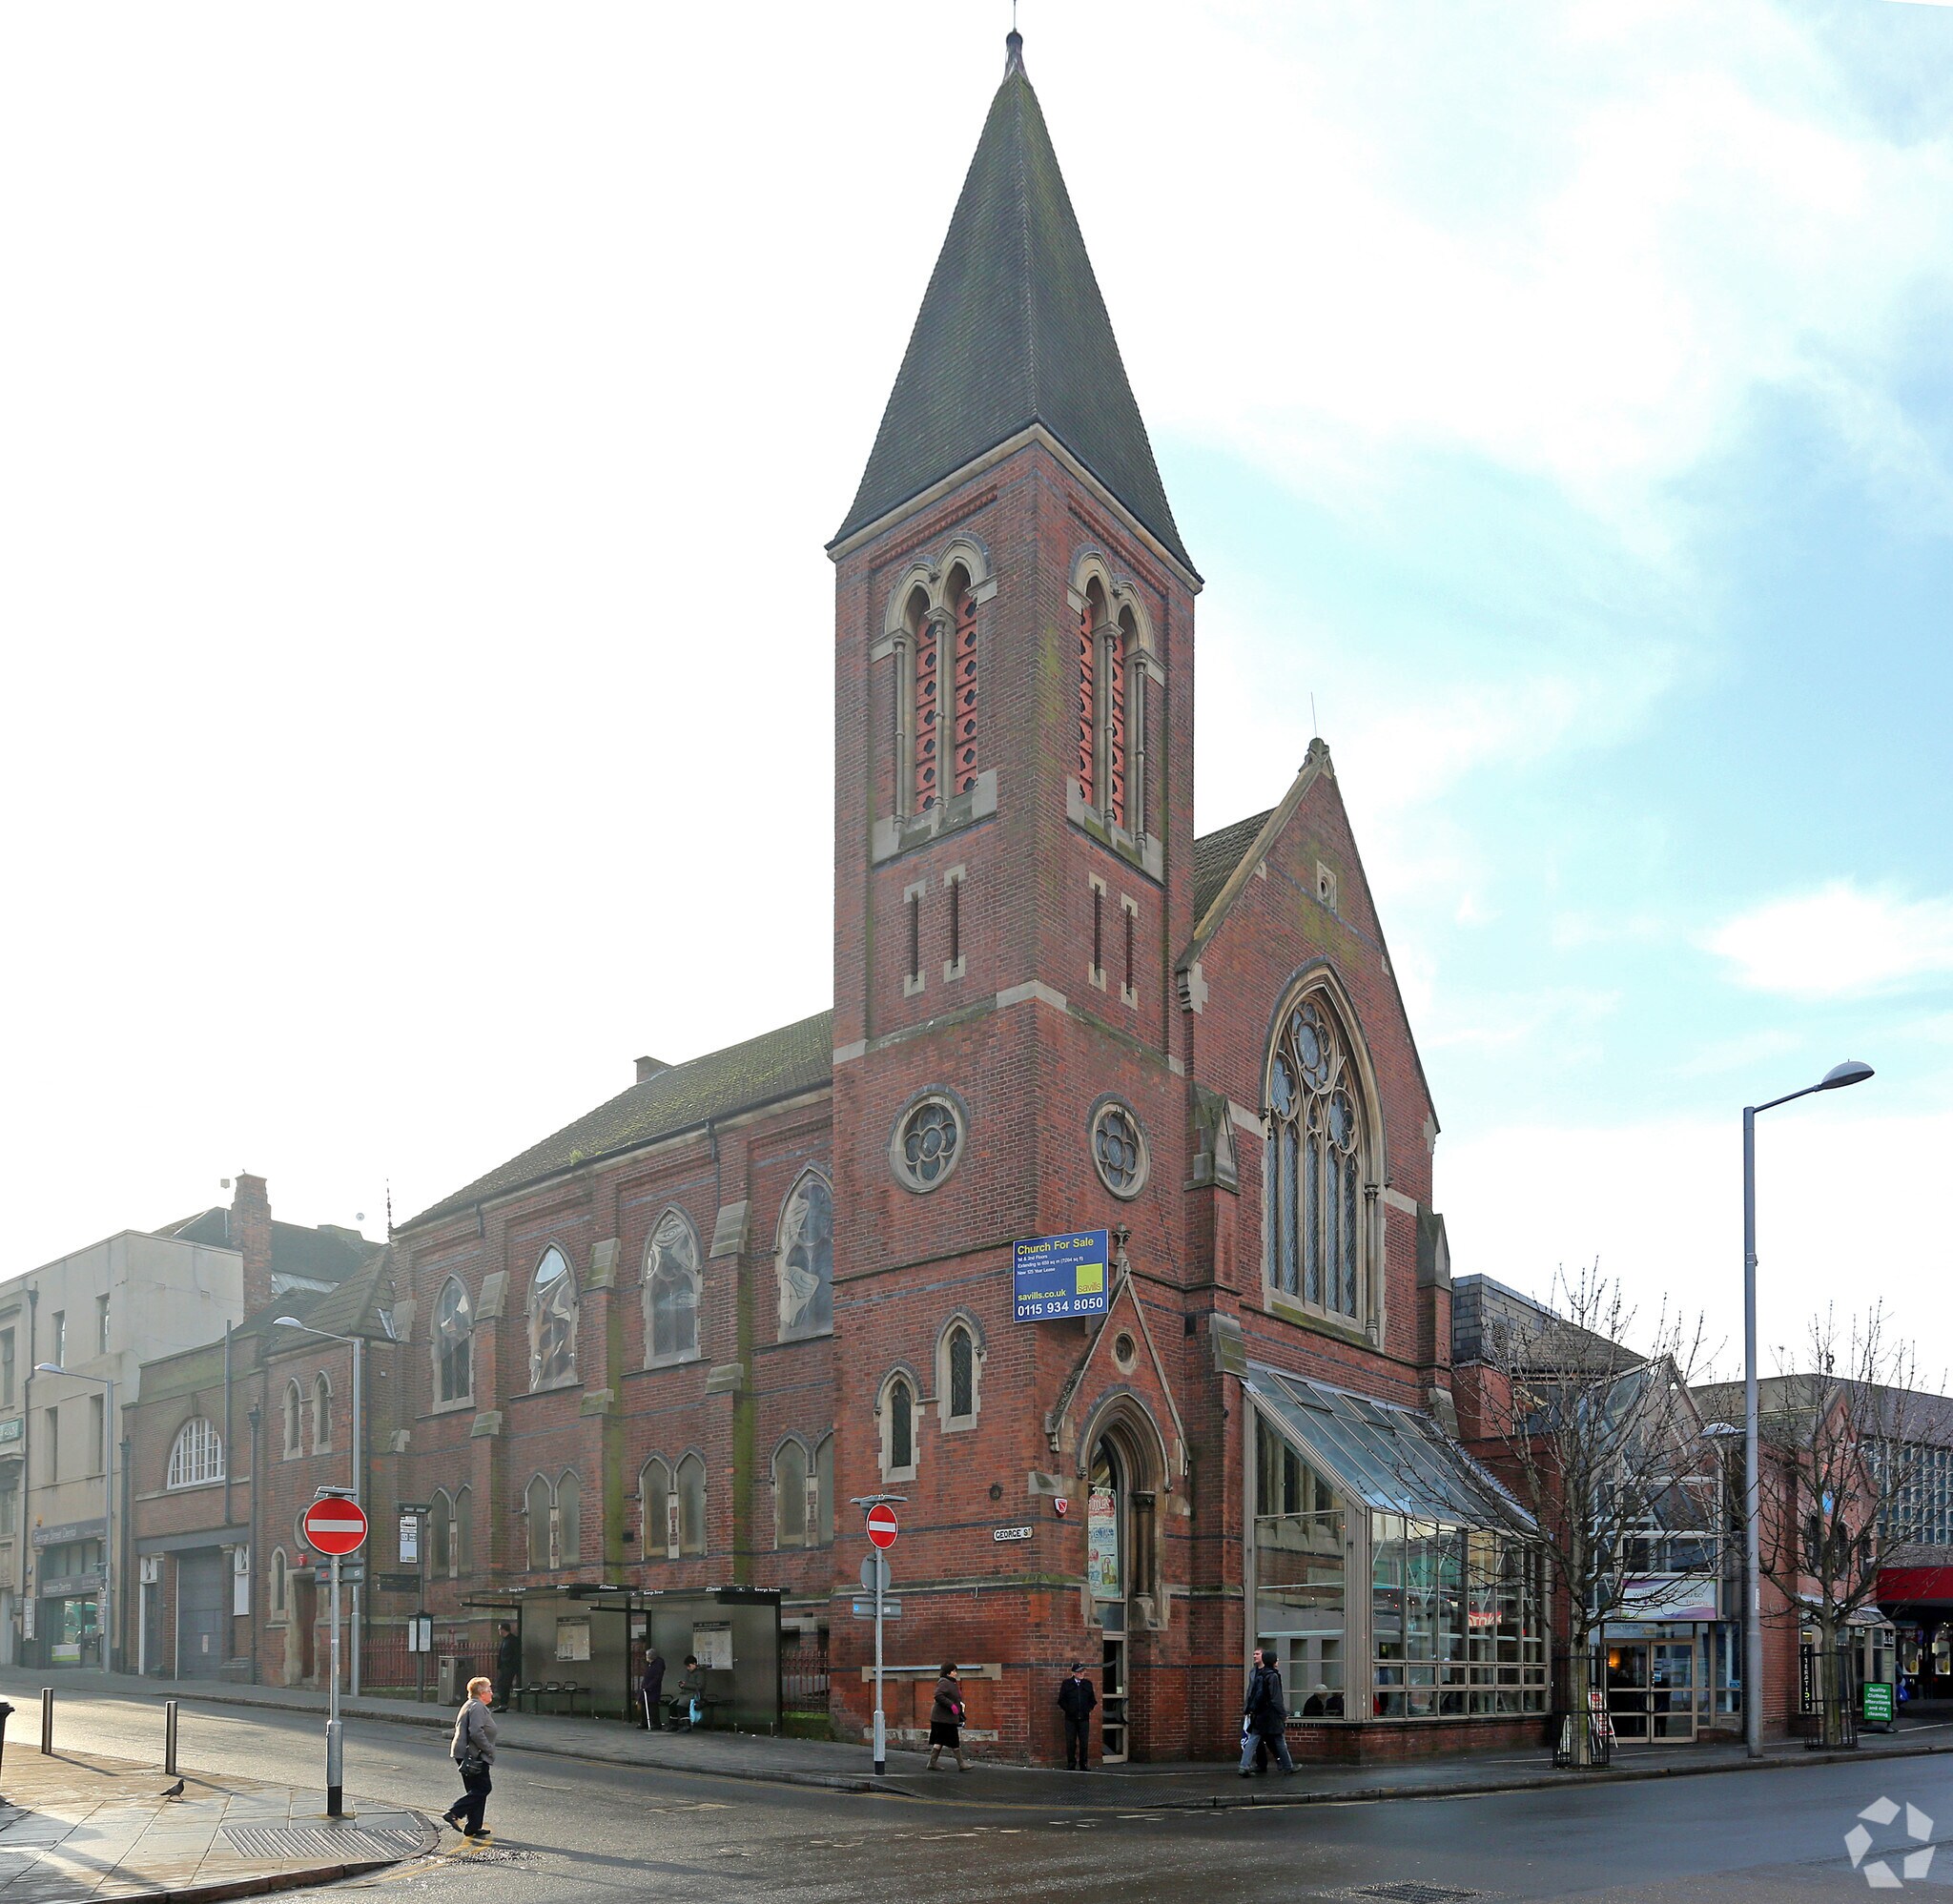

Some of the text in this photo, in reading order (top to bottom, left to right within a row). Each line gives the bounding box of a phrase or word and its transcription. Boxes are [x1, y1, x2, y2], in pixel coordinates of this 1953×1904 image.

[1018, 1238, 1094, 1256] Church For Sale
[1078, 1281, 1101, 1293] savills
[1018, 1289, 1066, 1301] savills.co.uk
[1018, 1297, 1103, 1317] 0115 934 8050
[995, 1528, 1021, 1539] GEORGE
